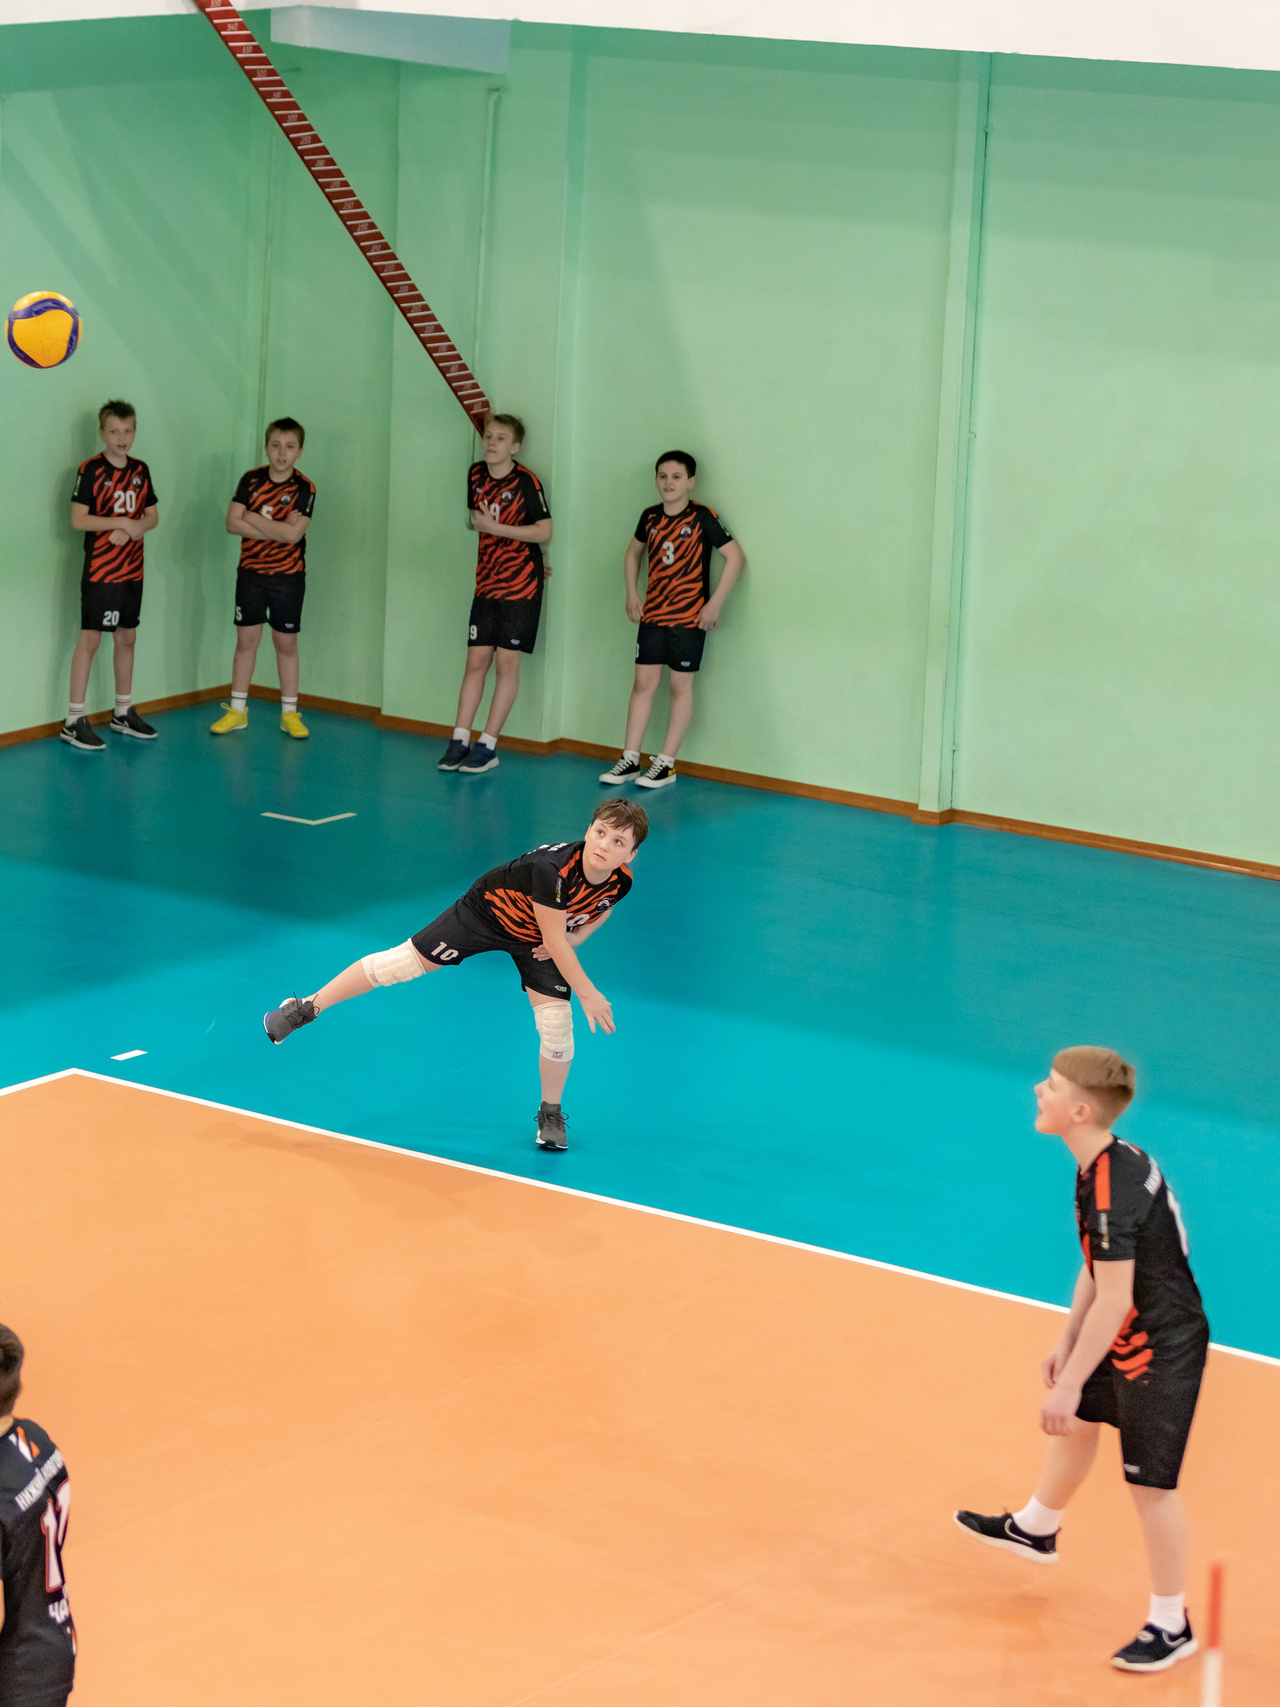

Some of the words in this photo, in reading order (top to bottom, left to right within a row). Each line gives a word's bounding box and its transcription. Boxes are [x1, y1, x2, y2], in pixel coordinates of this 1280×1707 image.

[113, 490, 136, 514] 20
[261, 505, 274, 520] 5
[661, 541, 675, 565] 3
[102, 610, 120, 626] 20
[235, 606, 243, 621] 5
[430, 941, 459, 961] 10
